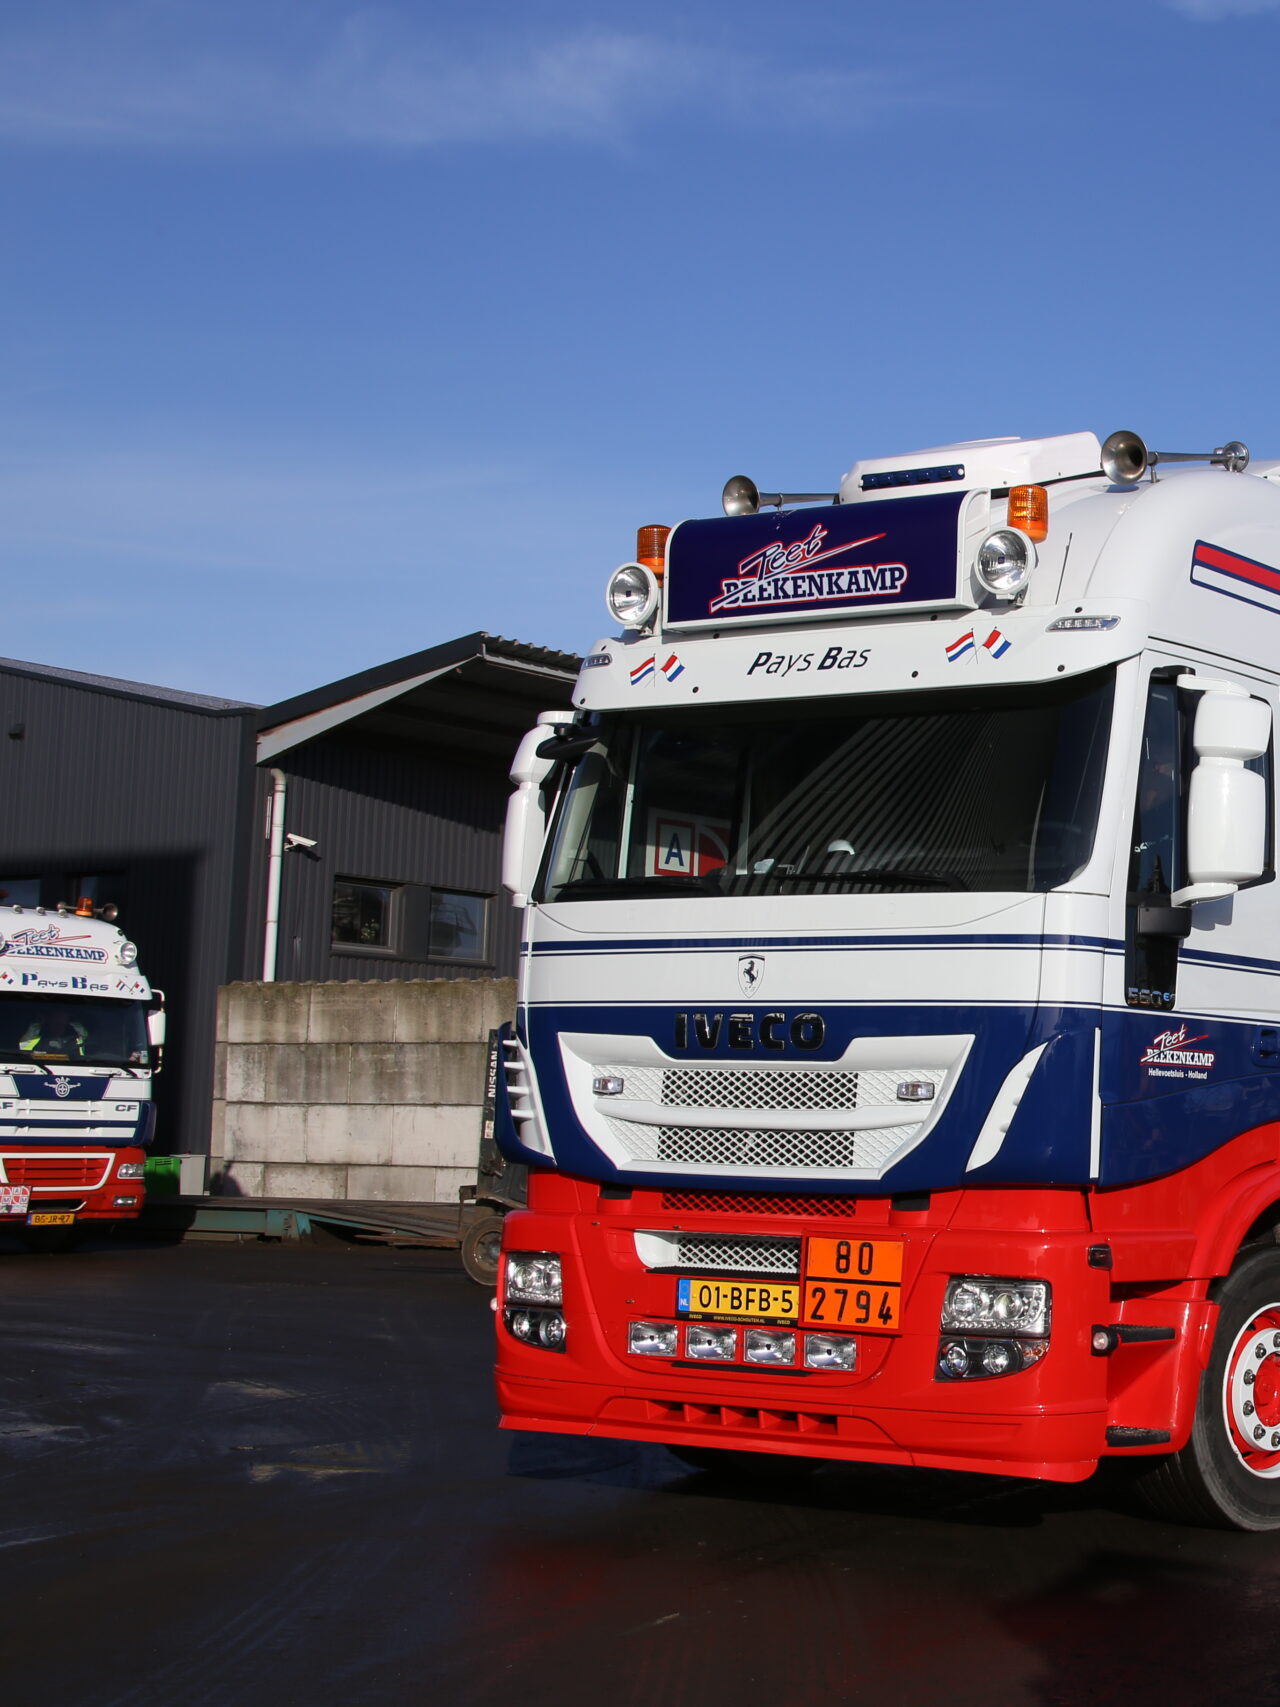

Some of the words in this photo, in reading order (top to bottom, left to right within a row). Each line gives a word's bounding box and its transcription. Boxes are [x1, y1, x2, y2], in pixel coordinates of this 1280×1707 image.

[740, 525, 828, 581] Peet
[723, 566, 905, 605] BEEKENKAMP
[747, 651, 815, 677] Pays
[817, 646, 871, 670] Bas
[665, 832, 684, 867] A
[12, 926, 59, 946] Peet
[675, 1012, 825, 1050] IVECO
[1153, 1024, 1186, 1050] Peet
[1146, 1048, 1215, 1067] BEEKENKAMP
[1148, 1067, 1184, 1078] Hellevoetsluis
[1188, 1070, 1208, 1079] Holland
[488, 1051, 498, 1098] NISSAN
[115, 1104, 138, 1112] CF
[835, 1240, 874, 1275] 80
[680, 1298, 689, 1306] NL
[699, 1284, 793, 1313] 01-BFB-5
[810, 1287, 893, 1326] 2794
